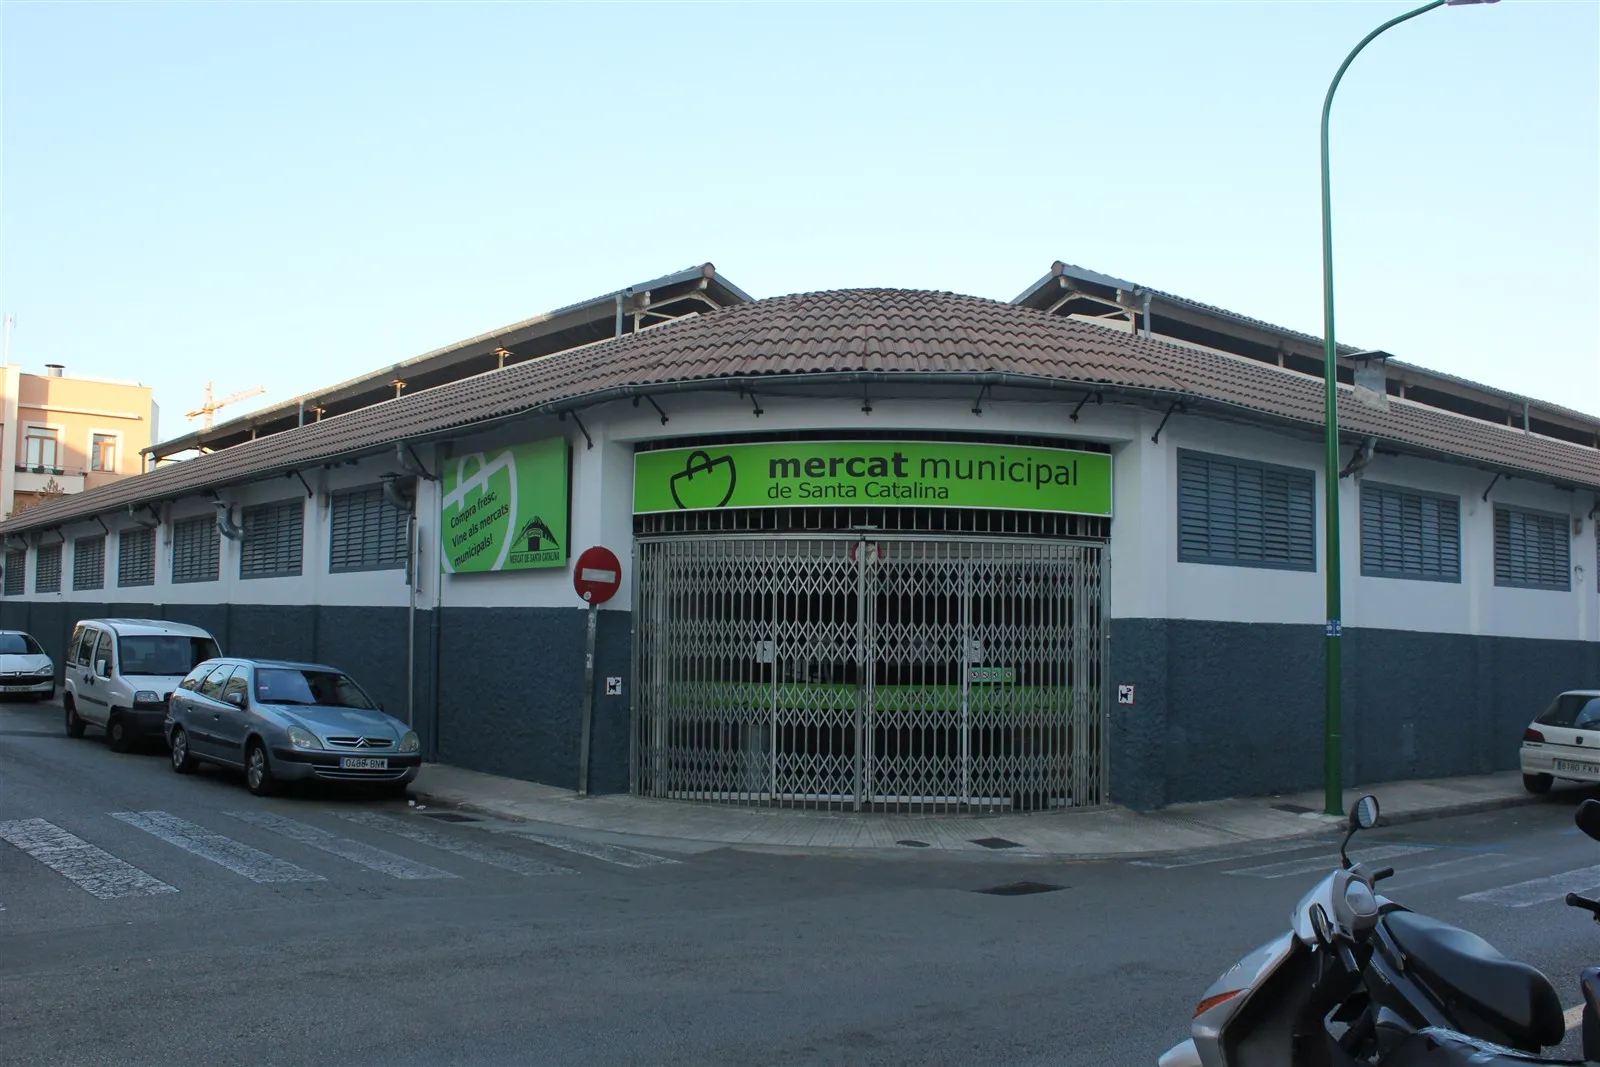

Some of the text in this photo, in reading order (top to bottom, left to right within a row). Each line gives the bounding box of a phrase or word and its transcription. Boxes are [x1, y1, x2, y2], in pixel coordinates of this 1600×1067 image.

[769, 452, 1077, 490] mercat municipal
[767, 481, 949, 499] de Santa Catalina
[450, 506, 477, 529] Compra
[452, 503, 509, 548] Vine als mercats
[454, 533, 493, 568] municipals!
